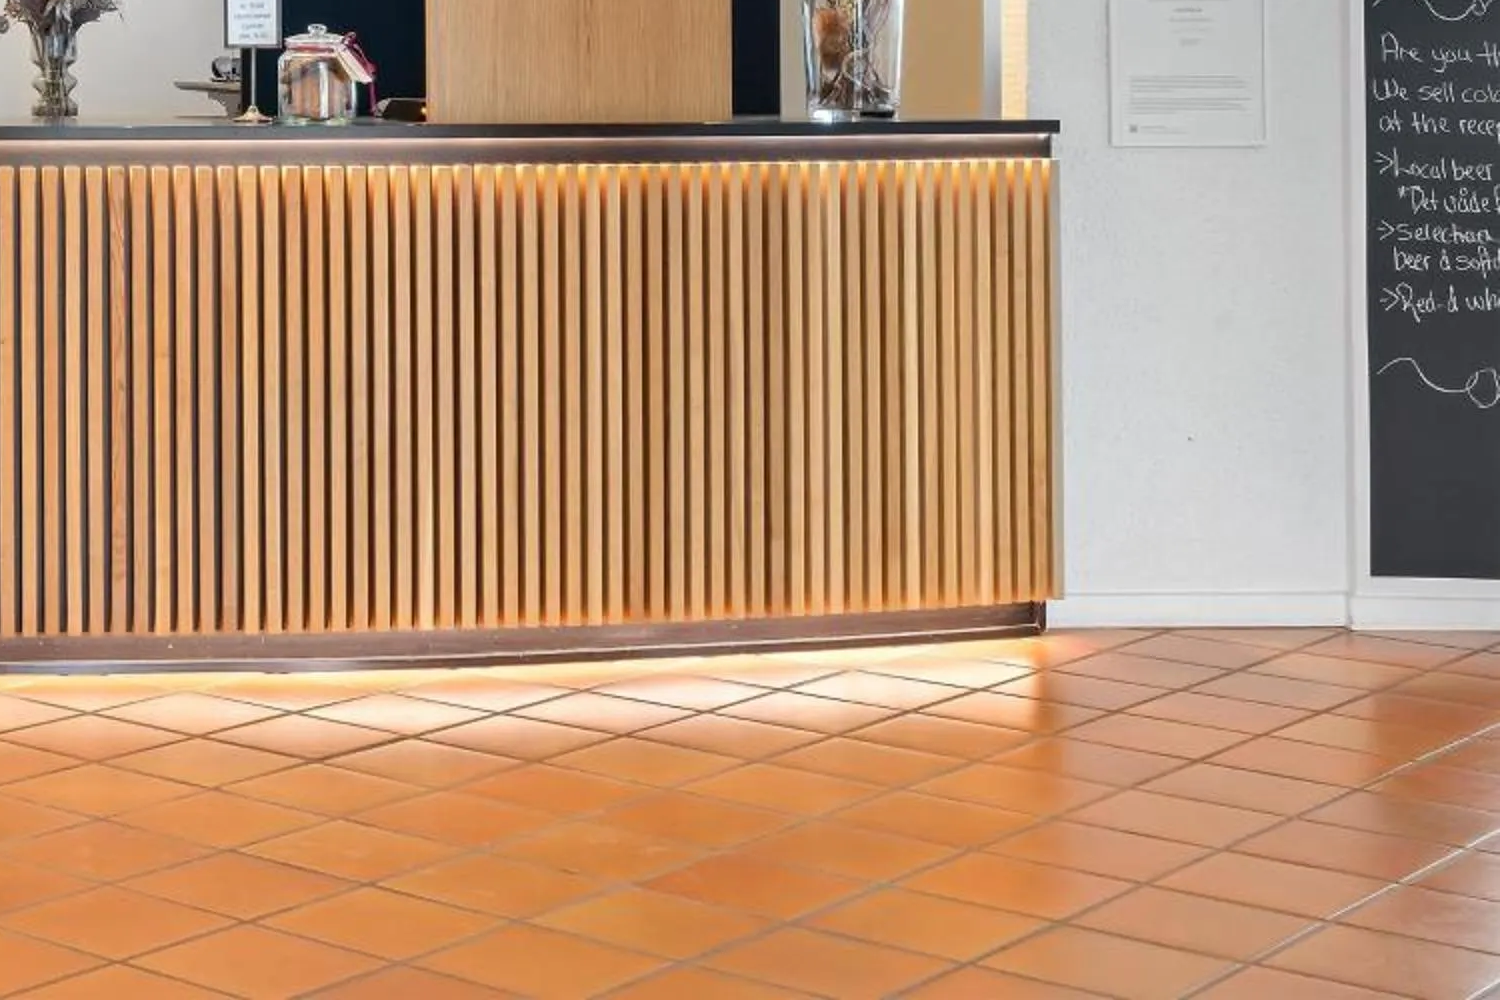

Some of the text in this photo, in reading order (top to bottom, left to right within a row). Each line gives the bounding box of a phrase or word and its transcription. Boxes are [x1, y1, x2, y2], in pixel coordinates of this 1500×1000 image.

[1380, 32, 1424, 64] Are
[1431, 47, 1473, 73] you
[1373, 76, 1410, 102] We
[1417, 81, 1456, 103] sell
[1412, 111, 1451, 135] the
[1451, 158, 1493, 181] beer
[1393, 246, 1431, 272] beer
